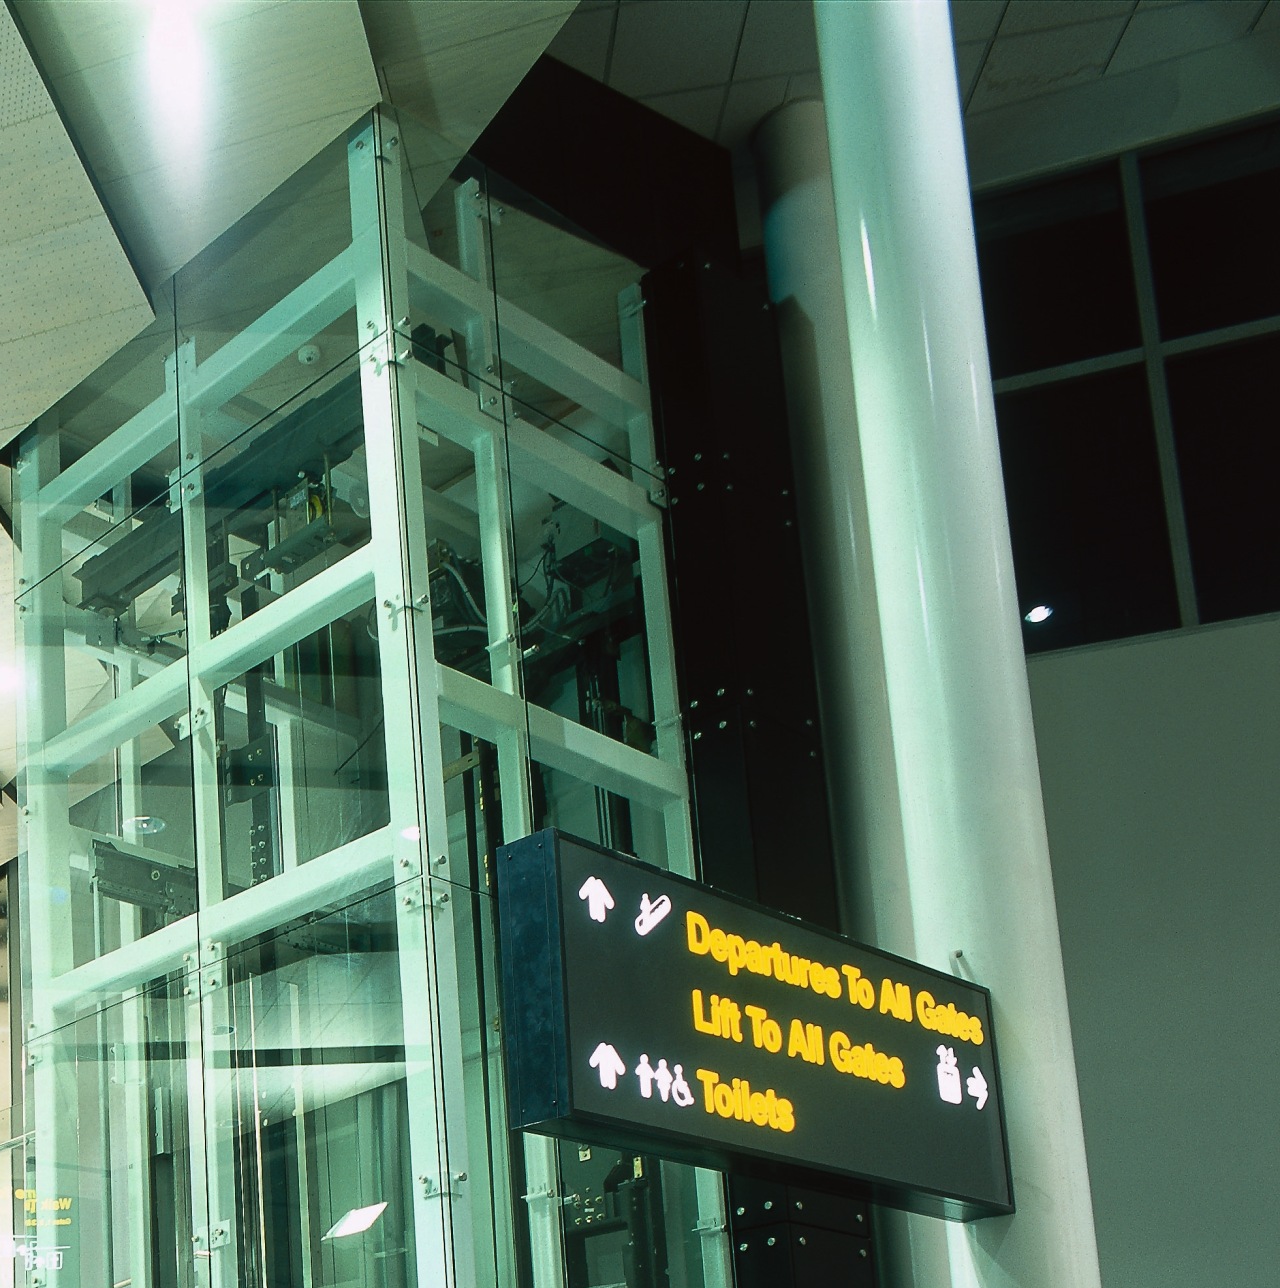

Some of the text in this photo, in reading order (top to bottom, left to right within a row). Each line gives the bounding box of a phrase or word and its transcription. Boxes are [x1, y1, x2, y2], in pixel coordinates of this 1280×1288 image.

[686, 911, 984, 1045] Departures To All Gates
[692, 989, 905, 1089] Lift To All Gates
[696, 1070, 795, 1132] Toilets
